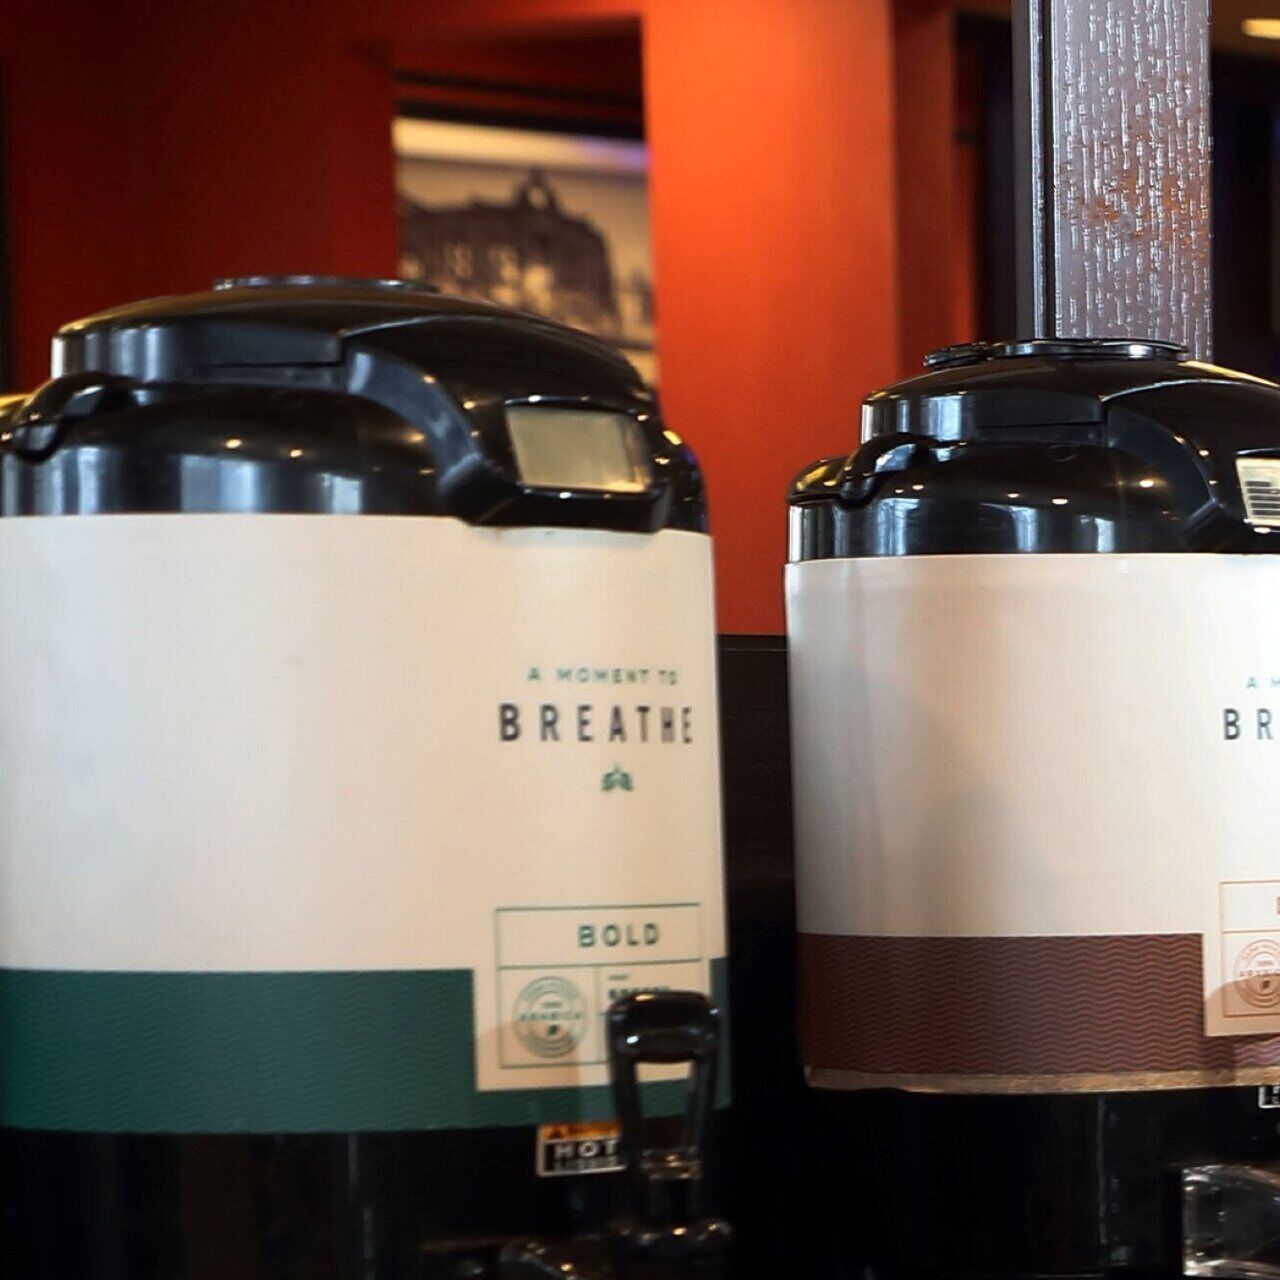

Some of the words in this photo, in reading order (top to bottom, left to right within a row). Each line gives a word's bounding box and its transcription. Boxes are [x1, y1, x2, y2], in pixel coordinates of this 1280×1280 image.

[528, 668, 540, 681] A
[556, 668, 649, 684] MOMENT
[658, 669, 677, 686] TO
[1245, 676, 1257, 689] A
[499, 703, 693, 743] BREATHE
[577, 923, 659, 948] BOLD
